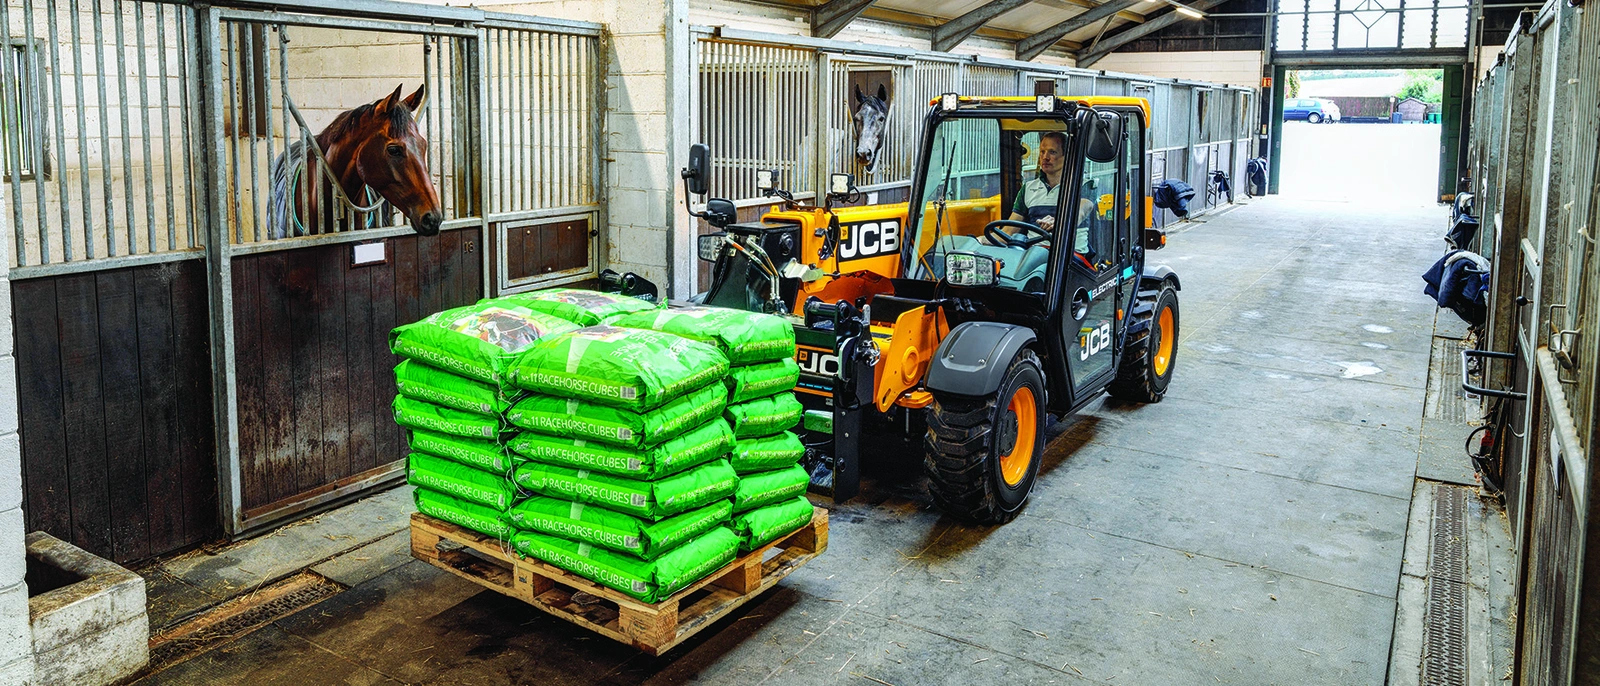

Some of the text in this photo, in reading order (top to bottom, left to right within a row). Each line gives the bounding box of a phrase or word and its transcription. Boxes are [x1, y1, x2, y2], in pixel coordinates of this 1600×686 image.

[840, 221, 899, 258] JCB
[1092, 277, 1117, 298] ELECTRIC
[1081, 323, 1110, 361] JCB
[410, 346, 418, 355] 11
[420, 348, 464, 370] RACEHORSE
[464, 364, 491, 379] CUBES
[530, 373, 538, 382] 11
[538, 374, 588, 391] RACEHORSE
[588, 382, 618, 398] CUBES
[458, 398, 481, 412] CUBES
[416, 416, 457, 433] RACEHORSE
[458, 422, 482, 436] CUBES
[531, 416, 538, 426] 11
[540, 416, 588, 432] RACEHORSE
[588, 424, 616, 438] CUBES
[422, 440, 429, 448] 11
[430, 442, 470, 460] RACEHORSE
[470, 452, 492, 466] CUBES
[537, 446, 544, 456] 11
[546, 447, 596, 464] RACEHORSE
[596, 455, 626, 469] CUBES
[423, 474, 429, 484] 11
[430, 476, 472, 497] RACEHORSE
[472, 488, 498, 503] CUBES
[549, 478, 598, 498] RACEHORSE
[599, 488, 630, 504] CUBES
[438, 508, 480, 529] RACEHORSE
[533, 518, 540, 528] 11
[542, 520, 592, 538] RACEHORSE
[594, 530, 622, 546] CUBES
[540, 548, 546, 558] 11
[548, 550, 599, 578] RACEHORSE
[600, 570, 630, 590] CUBES
